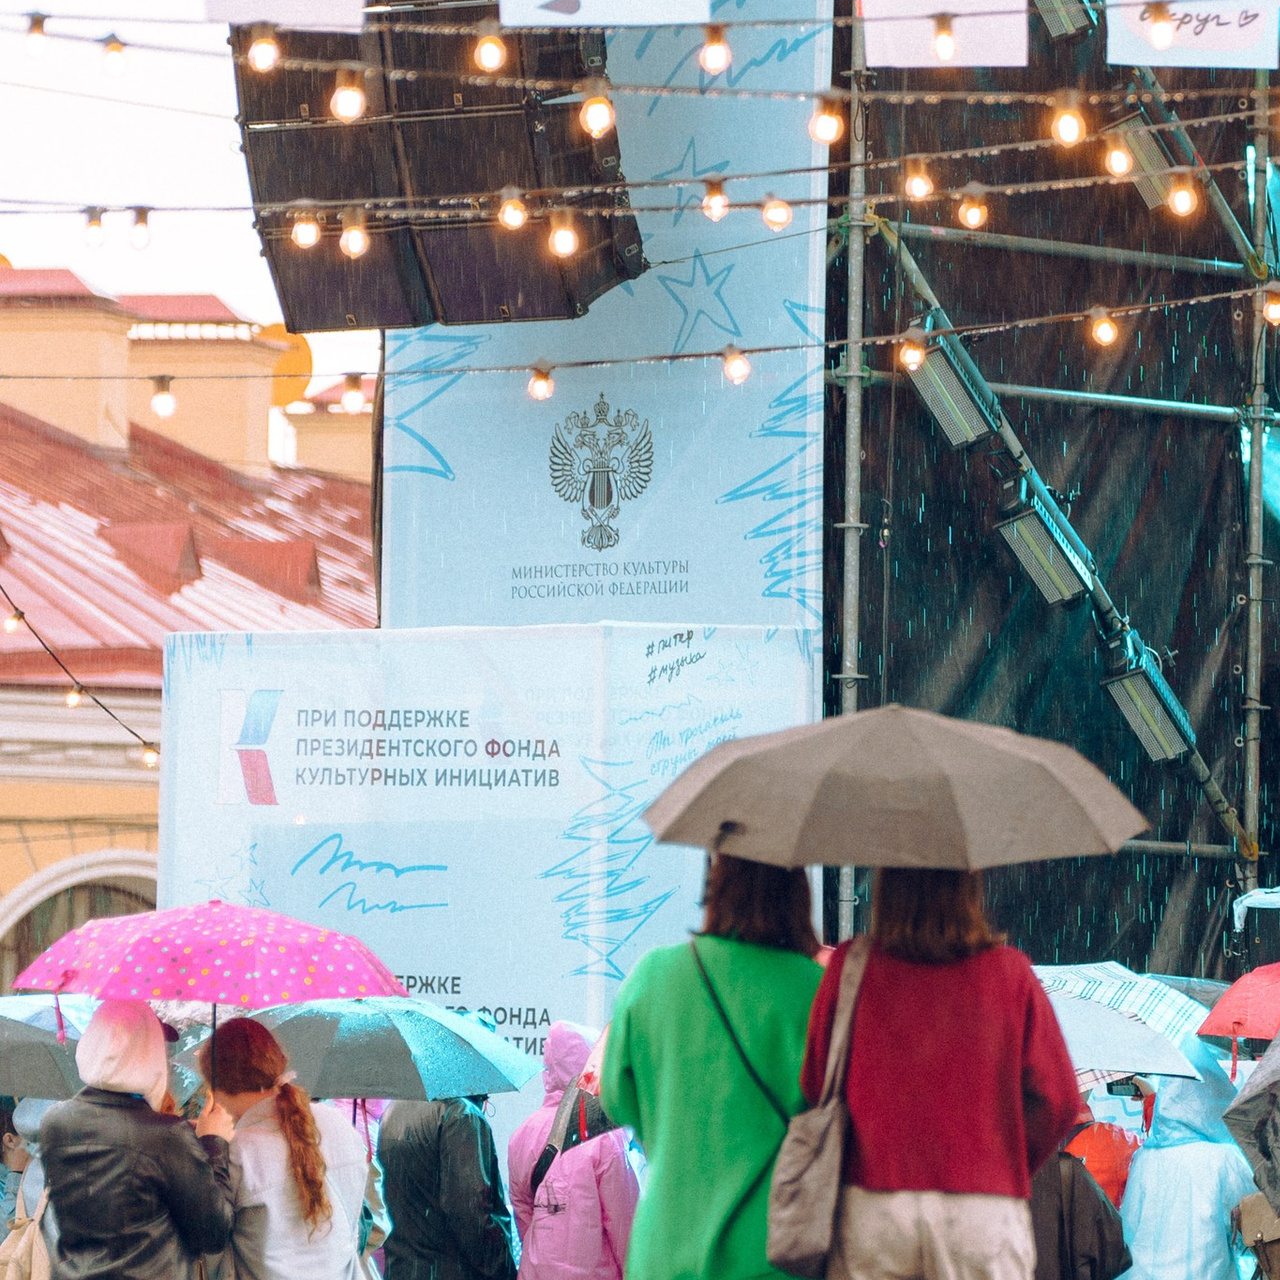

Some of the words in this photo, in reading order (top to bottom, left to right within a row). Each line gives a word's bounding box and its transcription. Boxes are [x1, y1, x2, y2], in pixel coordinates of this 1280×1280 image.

[510, 561, 619, 580] МИНИСТЕРСТВО
[622, 559, 690, 578] КУЛЬТУРЫ
[510, 578, 604, 598] РОССИЙСКОЙ
[607, 579, 690, 598] ФЕДЕРАЦИИ
[296, 708, 338, 728] ПРИ
[343, 708, 471, 730] ПОДДЕРЖКЕ
[295, 738, 479, 761] ПРЕЗИДЕНТСКОГО
[484, 738, 562, 761] ФОНДА
[294, 766, 429, 789] КУЛЬТУРНЫХ
[435, 766, 561, 790] ИНИЦИАТИВ
